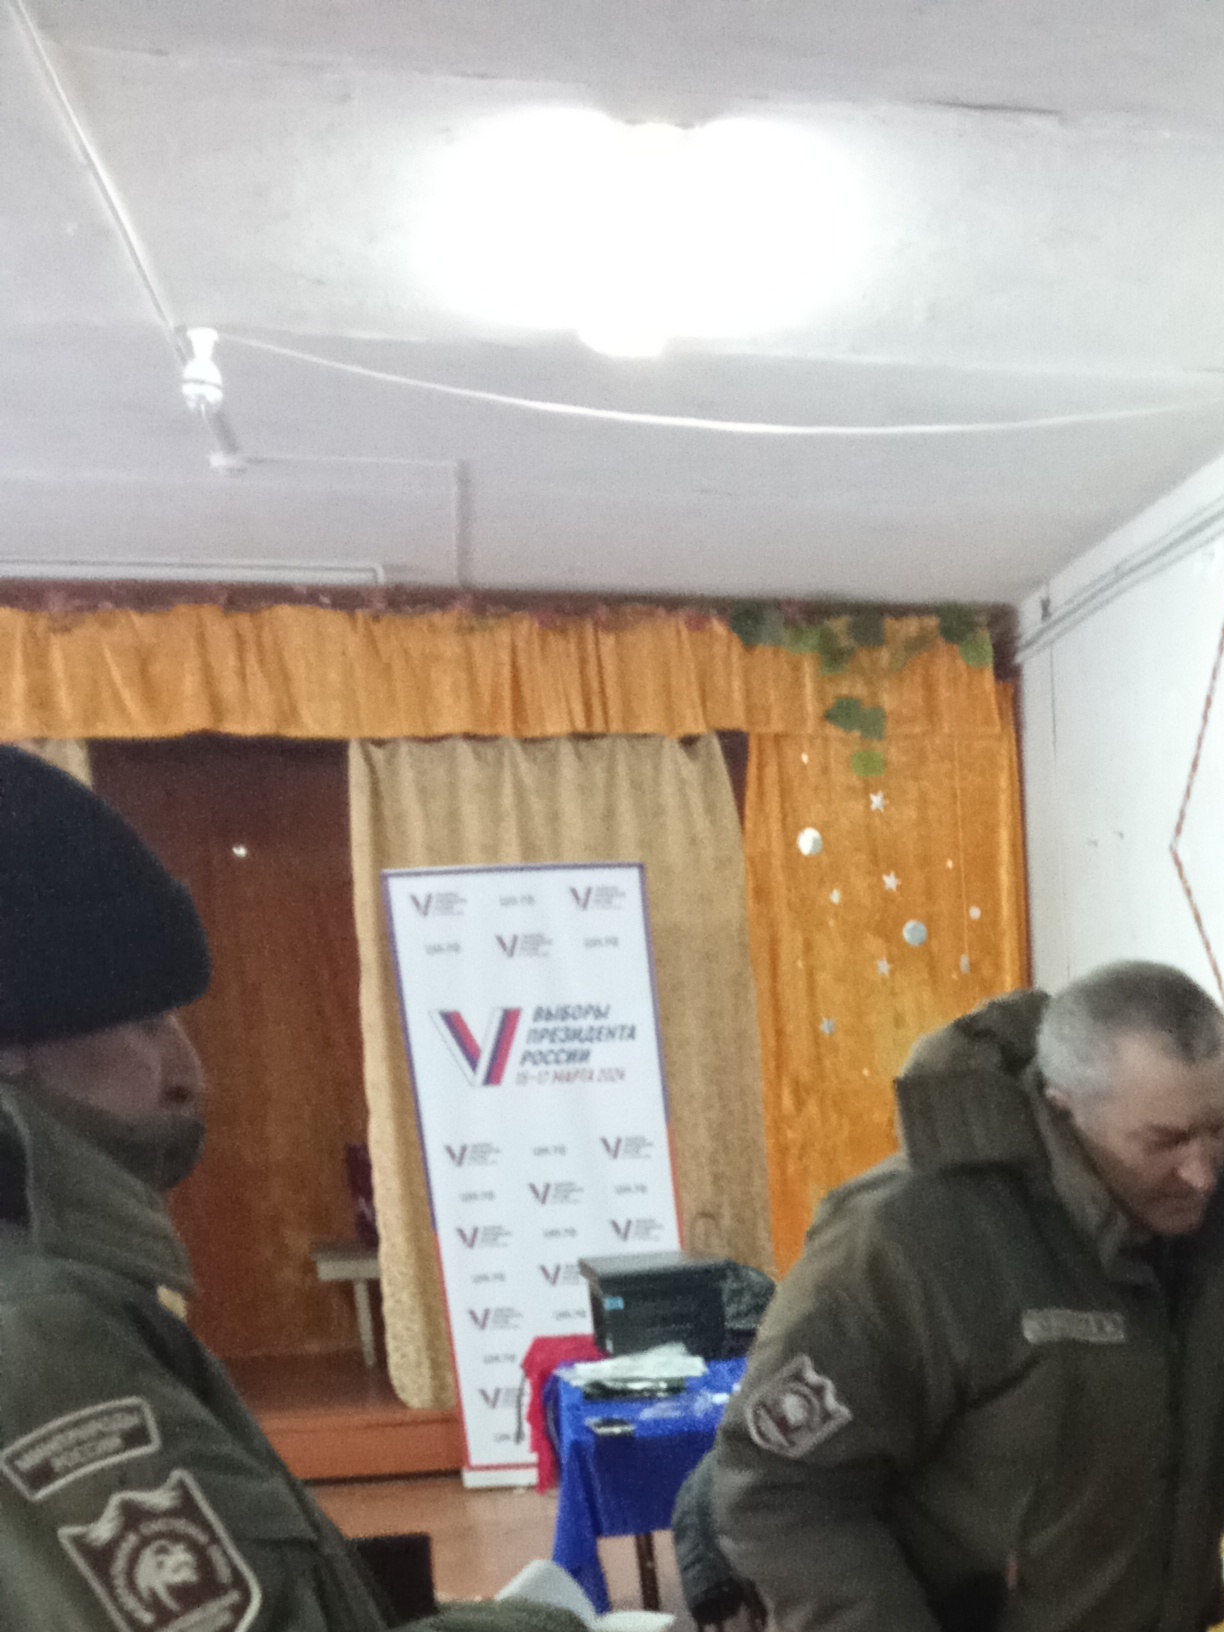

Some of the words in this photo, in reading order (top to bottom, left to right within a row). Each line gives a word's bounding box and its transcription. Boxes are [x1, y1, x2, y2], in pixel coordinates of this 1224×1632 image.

[532, 1002, 611, 1022] ВЫБОРЫ
[526, 1024, 637, 1044] ПРЕЗИДЕНТА
[520, 1047, 592, 1067] РОССИИ
